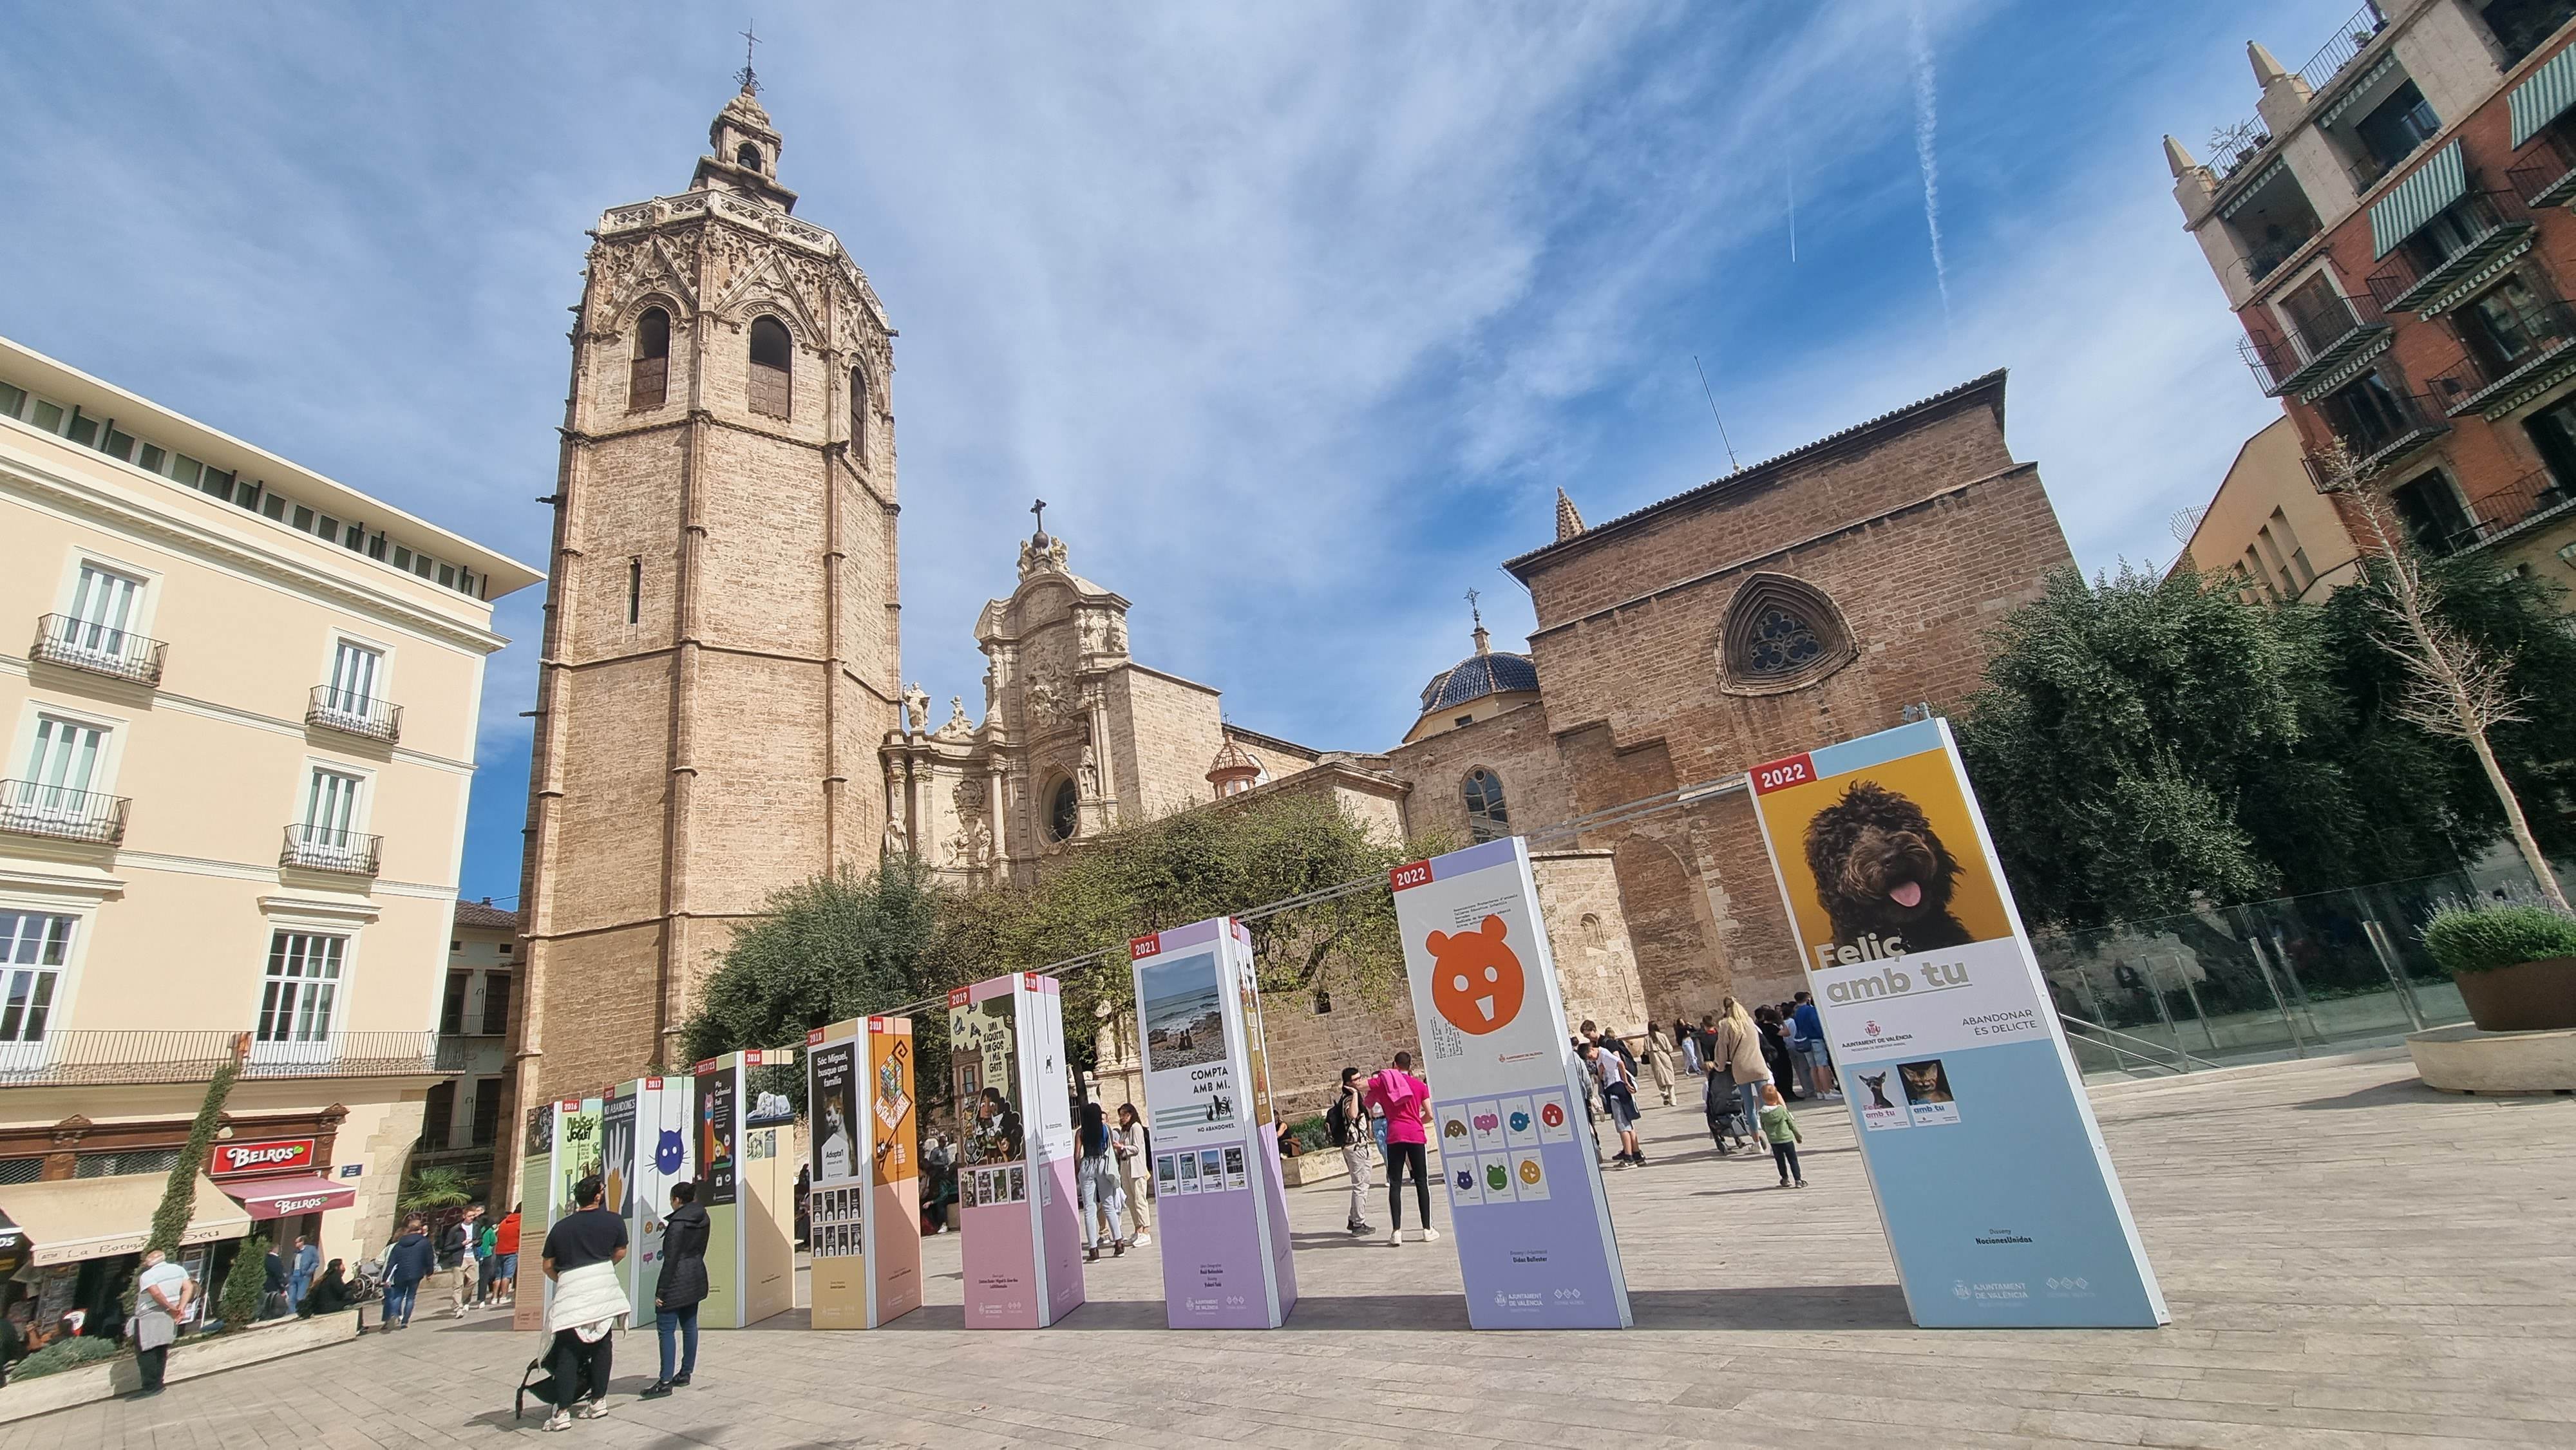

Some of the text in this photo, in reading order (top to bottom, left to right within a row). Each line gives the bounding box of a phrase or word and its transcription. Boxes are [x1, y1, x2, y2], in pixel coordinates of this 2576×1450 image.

[1761, 763, 1806, 789] 2022
[1396, 867, 1426, 886] 2022
[1135, 941, 1156, 956] 2021
[1813, 934, 1907, 968] Feliç
[1826, 960, 1970, 1003] amb tu
[952, 992, 967, 1005] 2019
[1962, 1009, 2034, 1027] ABANDONAR
[869, 1021, 882, 1030] 2018
[988, 1021, 998, 1031] UNA
[1974, 1020, 2038, 1036] ÉS DELICTE
[810, 1032, 822, 1043] 2018
[1842, 1039, 1877, 1048] AJUNTAMENT
[992, 1040, 1004, 1051] GOS
[747, 1053, 760, 1062] 2018
[989, 1061, 1002, 1073] GATS
[1191, 1066, 1228, 1080] COMPTA
[1193, 1080, 1230, 1094] AMB MI.
[226, 1145, 294, 1169] BELROS
[275, 1198, 321, 1215] BELROS
[1973, 1283, 2026, 1291] AJUNTAMENT
